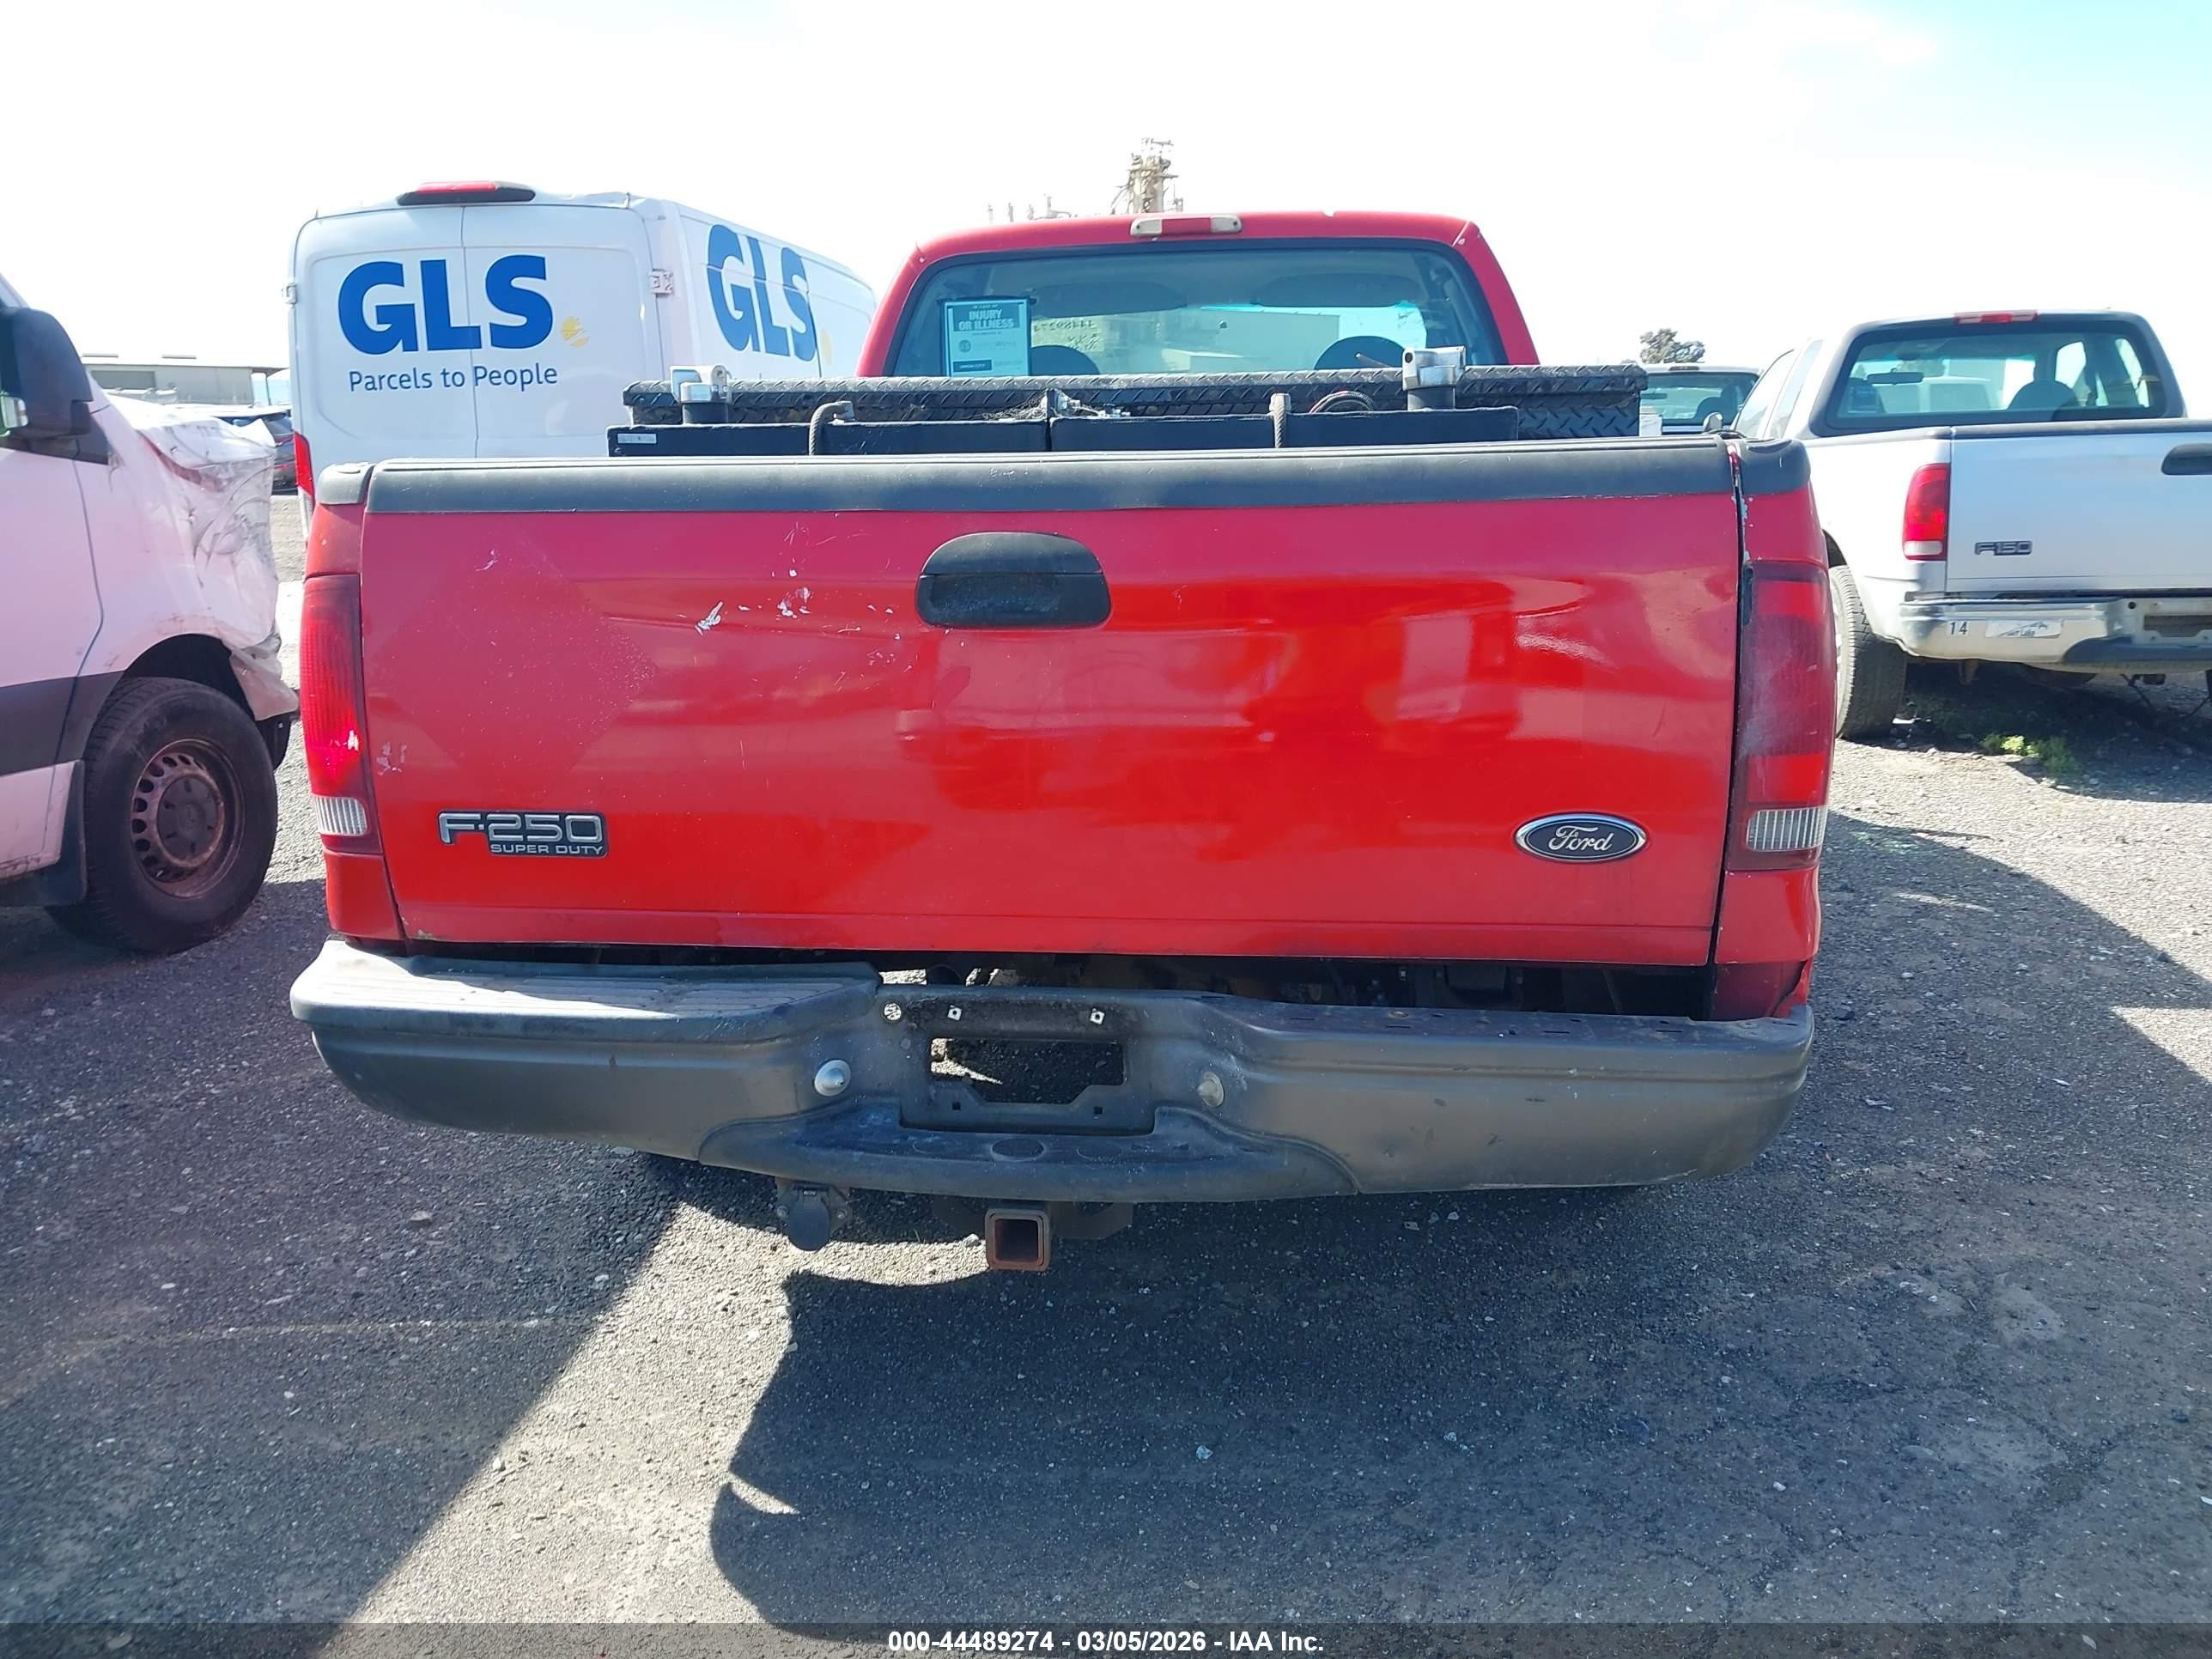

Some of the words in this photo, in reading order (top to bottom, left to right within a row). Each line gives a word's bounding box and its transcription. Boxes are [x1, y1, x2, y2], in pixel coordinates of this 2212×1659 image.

[707, 224, 817, 362] GLS
[337, 254, 553, 355] GLS
[969, 309, 1002, 320] INJURY
[958, 321, 972, 331] OR
[975, 319, 1014, 330] ILLNESS
[349, 368, 433, 392] Parcels
[441, 368, 465, 388] to
[473, 362, 557, 392] People
[1950, 622, 1968, 635] 14
[1548, 825, 1614, 851] Ford
[490, 844, 550, 854] SUPER
[556, 845, 603, 854] DUTY
